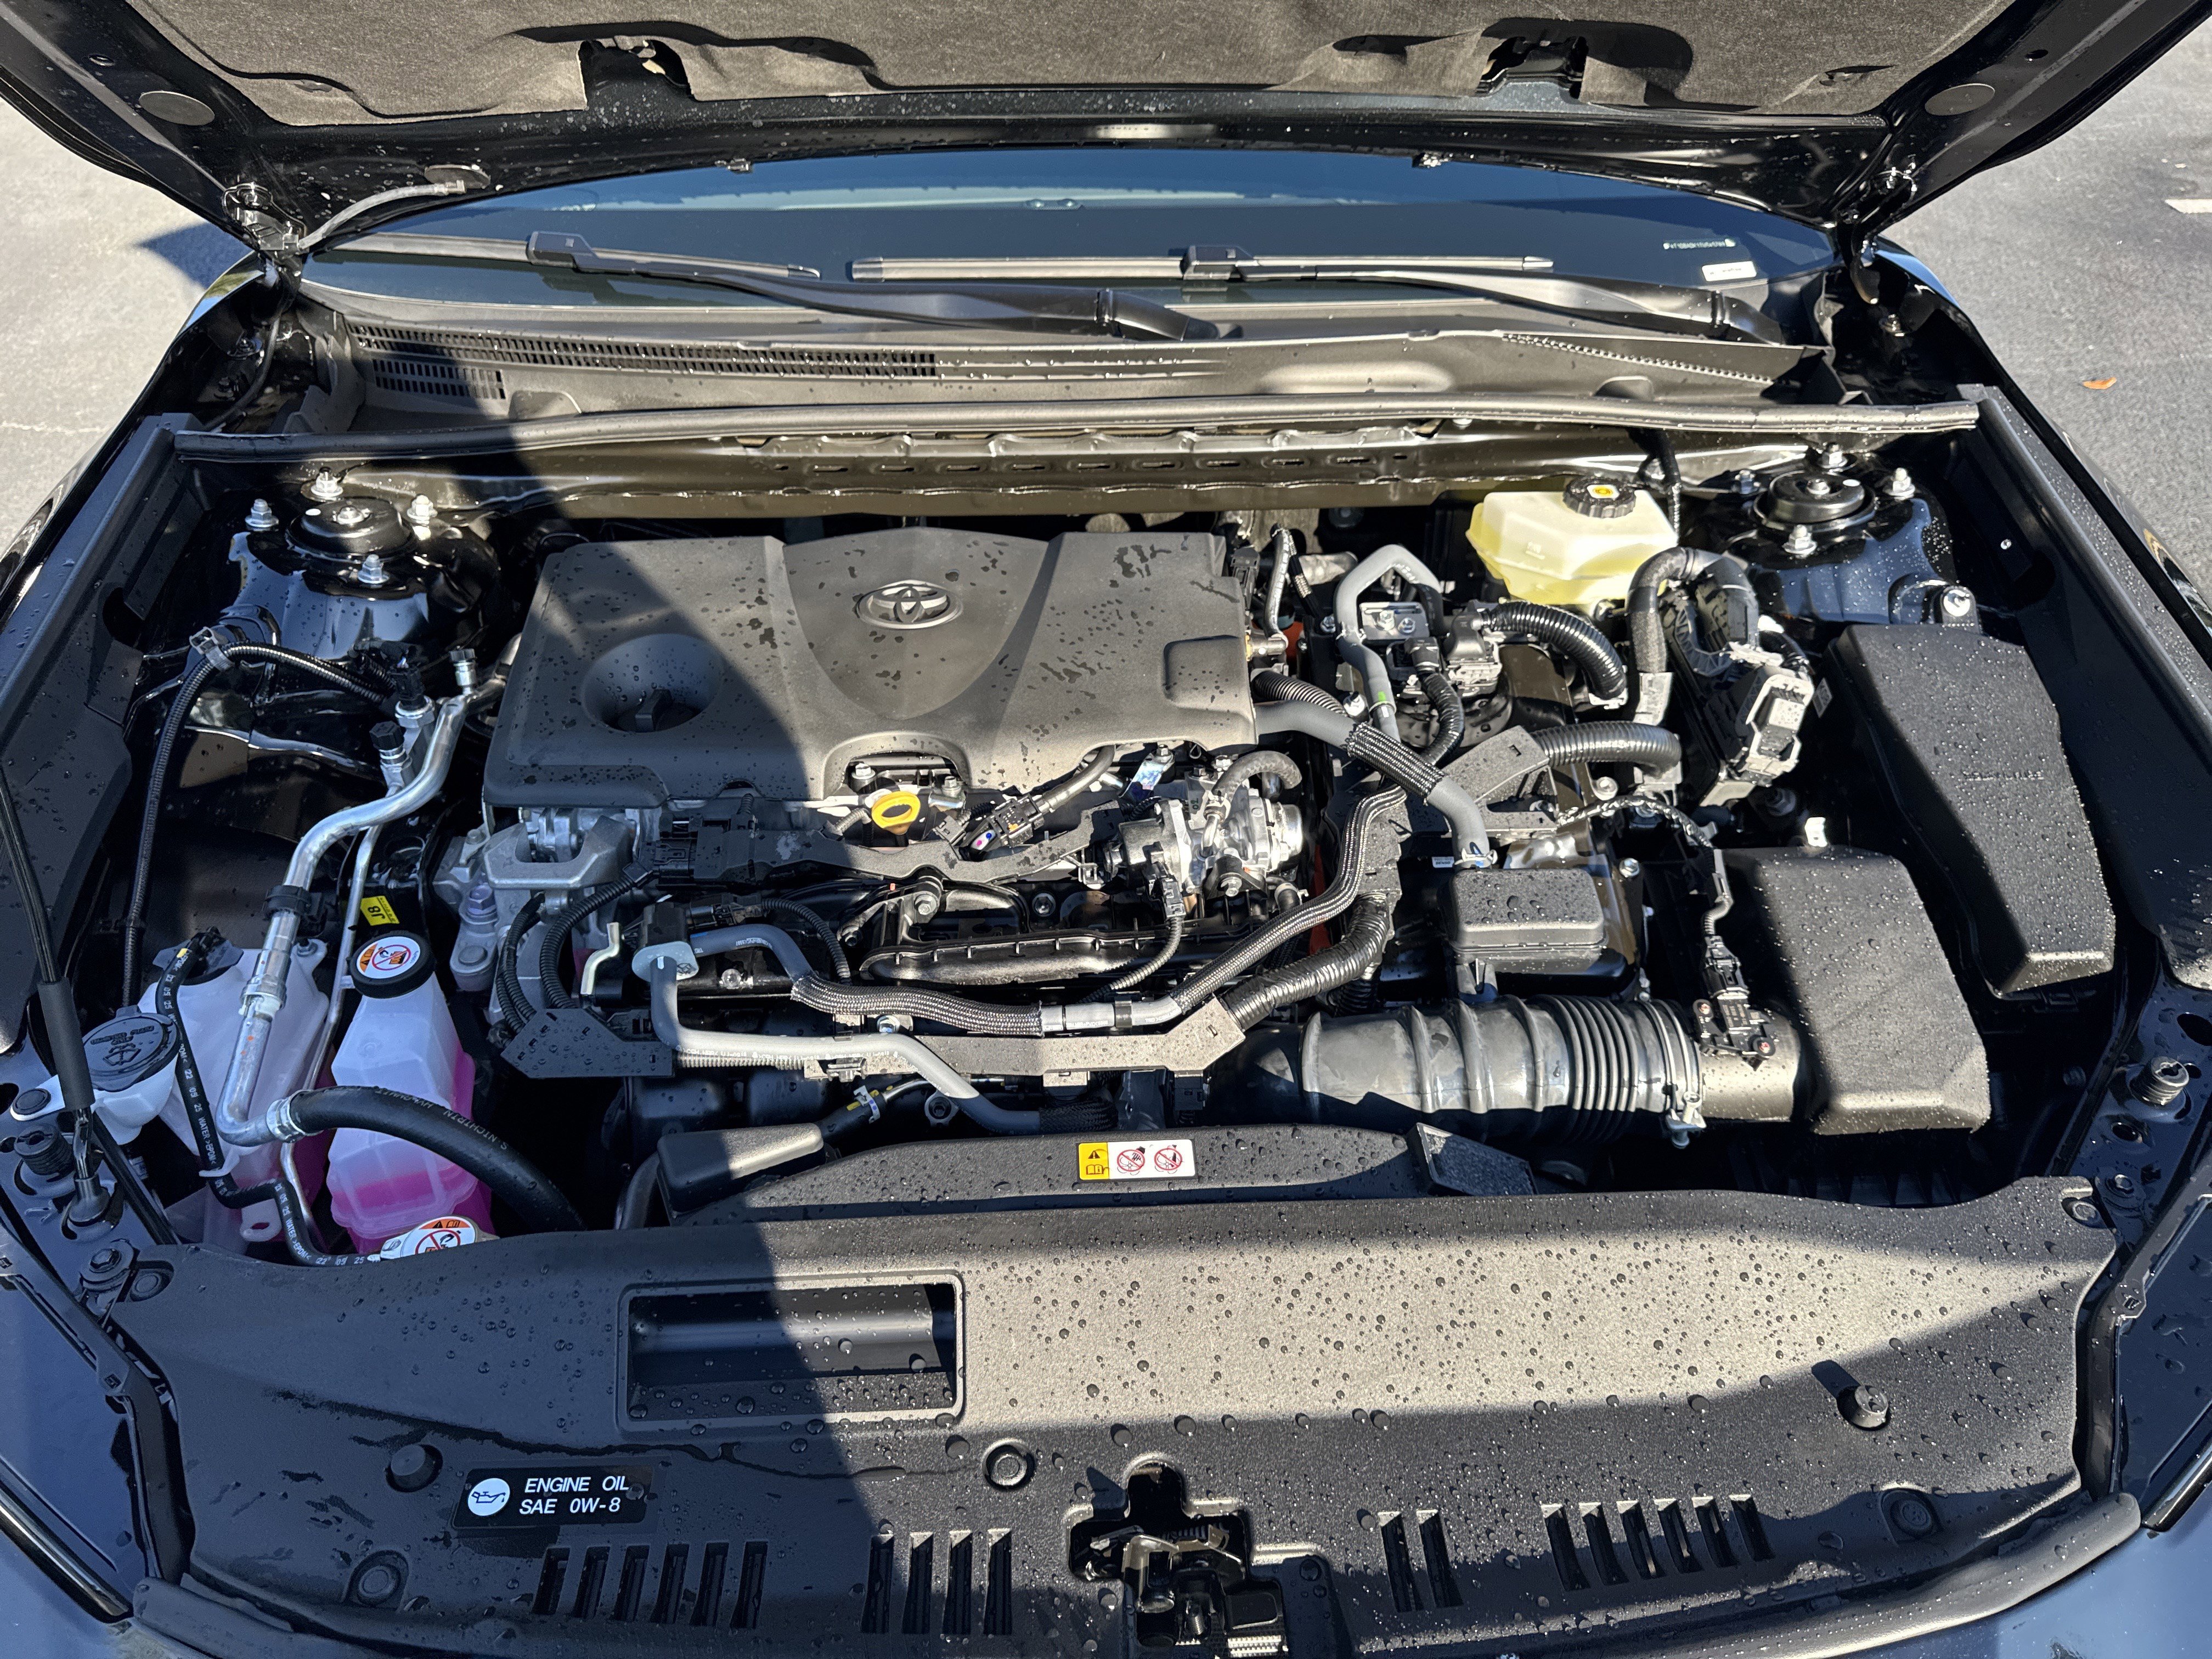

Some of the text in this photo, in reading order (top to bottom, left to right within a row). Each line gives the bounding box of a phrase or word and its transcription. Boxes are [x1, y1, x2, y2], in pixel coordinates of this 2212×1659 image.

[368, 906, 385, 919] J8
[184, 1068, 193, 1080] 22
[194, 1103, 203, 1113] 25
[354, 1256, 365, 1265] 25
[524, 1476, 629, 1493] ENGINE OIL
[519, 1497, 621, 1515] SAE 0W-8
